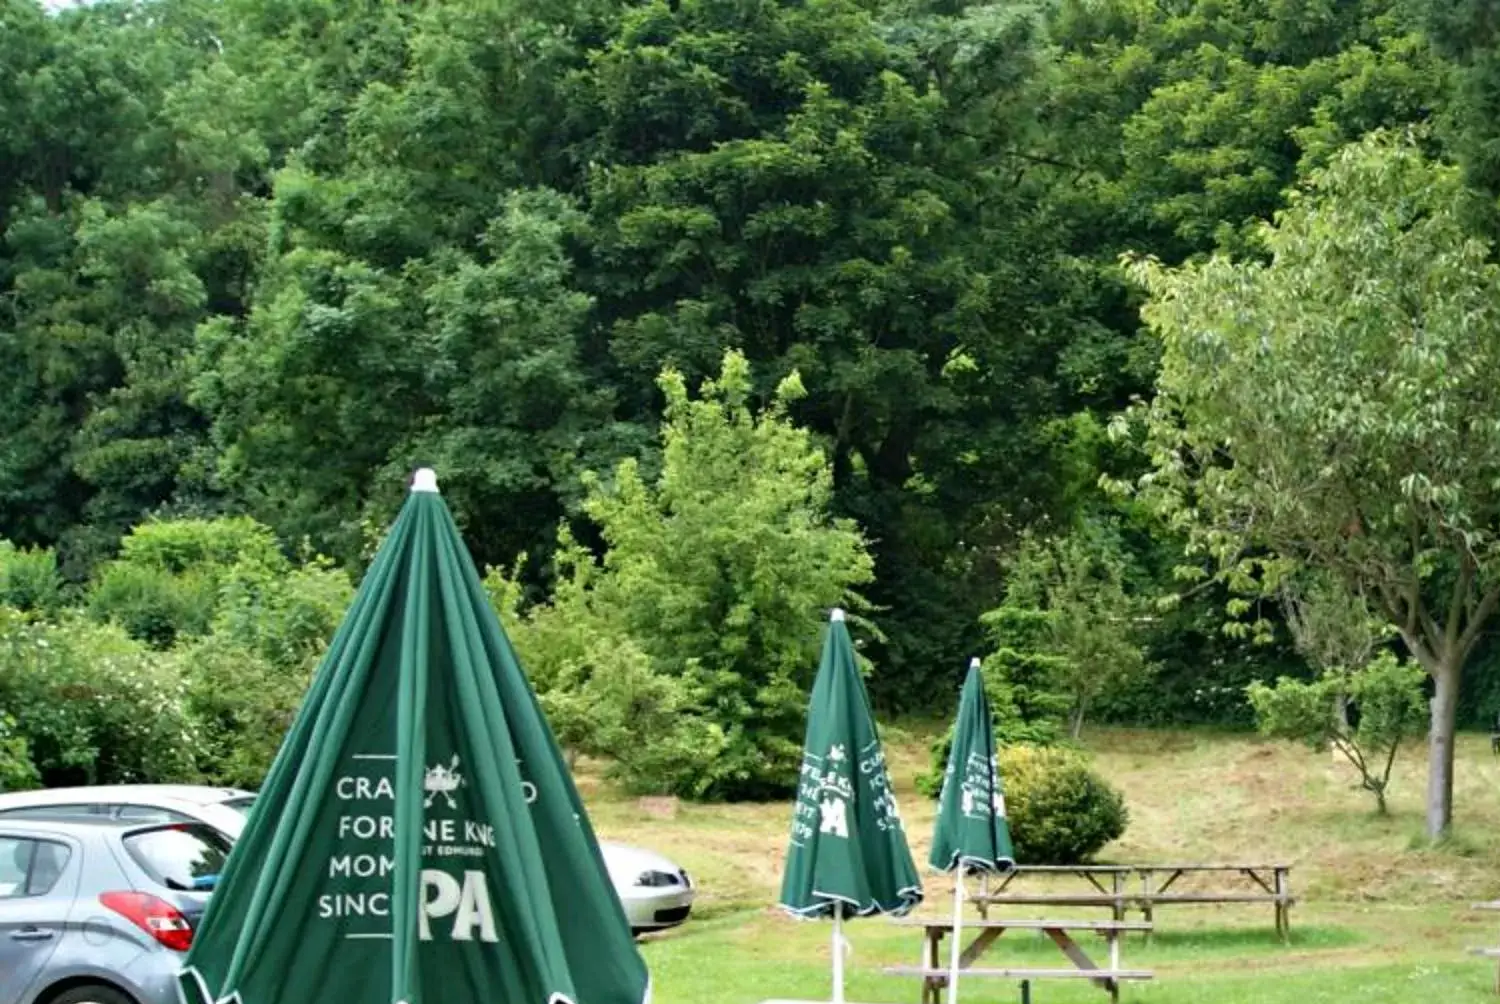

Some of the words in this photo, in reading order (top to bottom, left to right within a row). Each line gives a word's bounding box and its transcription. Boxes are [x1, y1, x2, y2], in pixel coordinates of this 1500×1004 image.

[339, 816, 395, 838] FOR
[319, 893, 390, 918] SINC
[418, 868, 499, 942] PA
